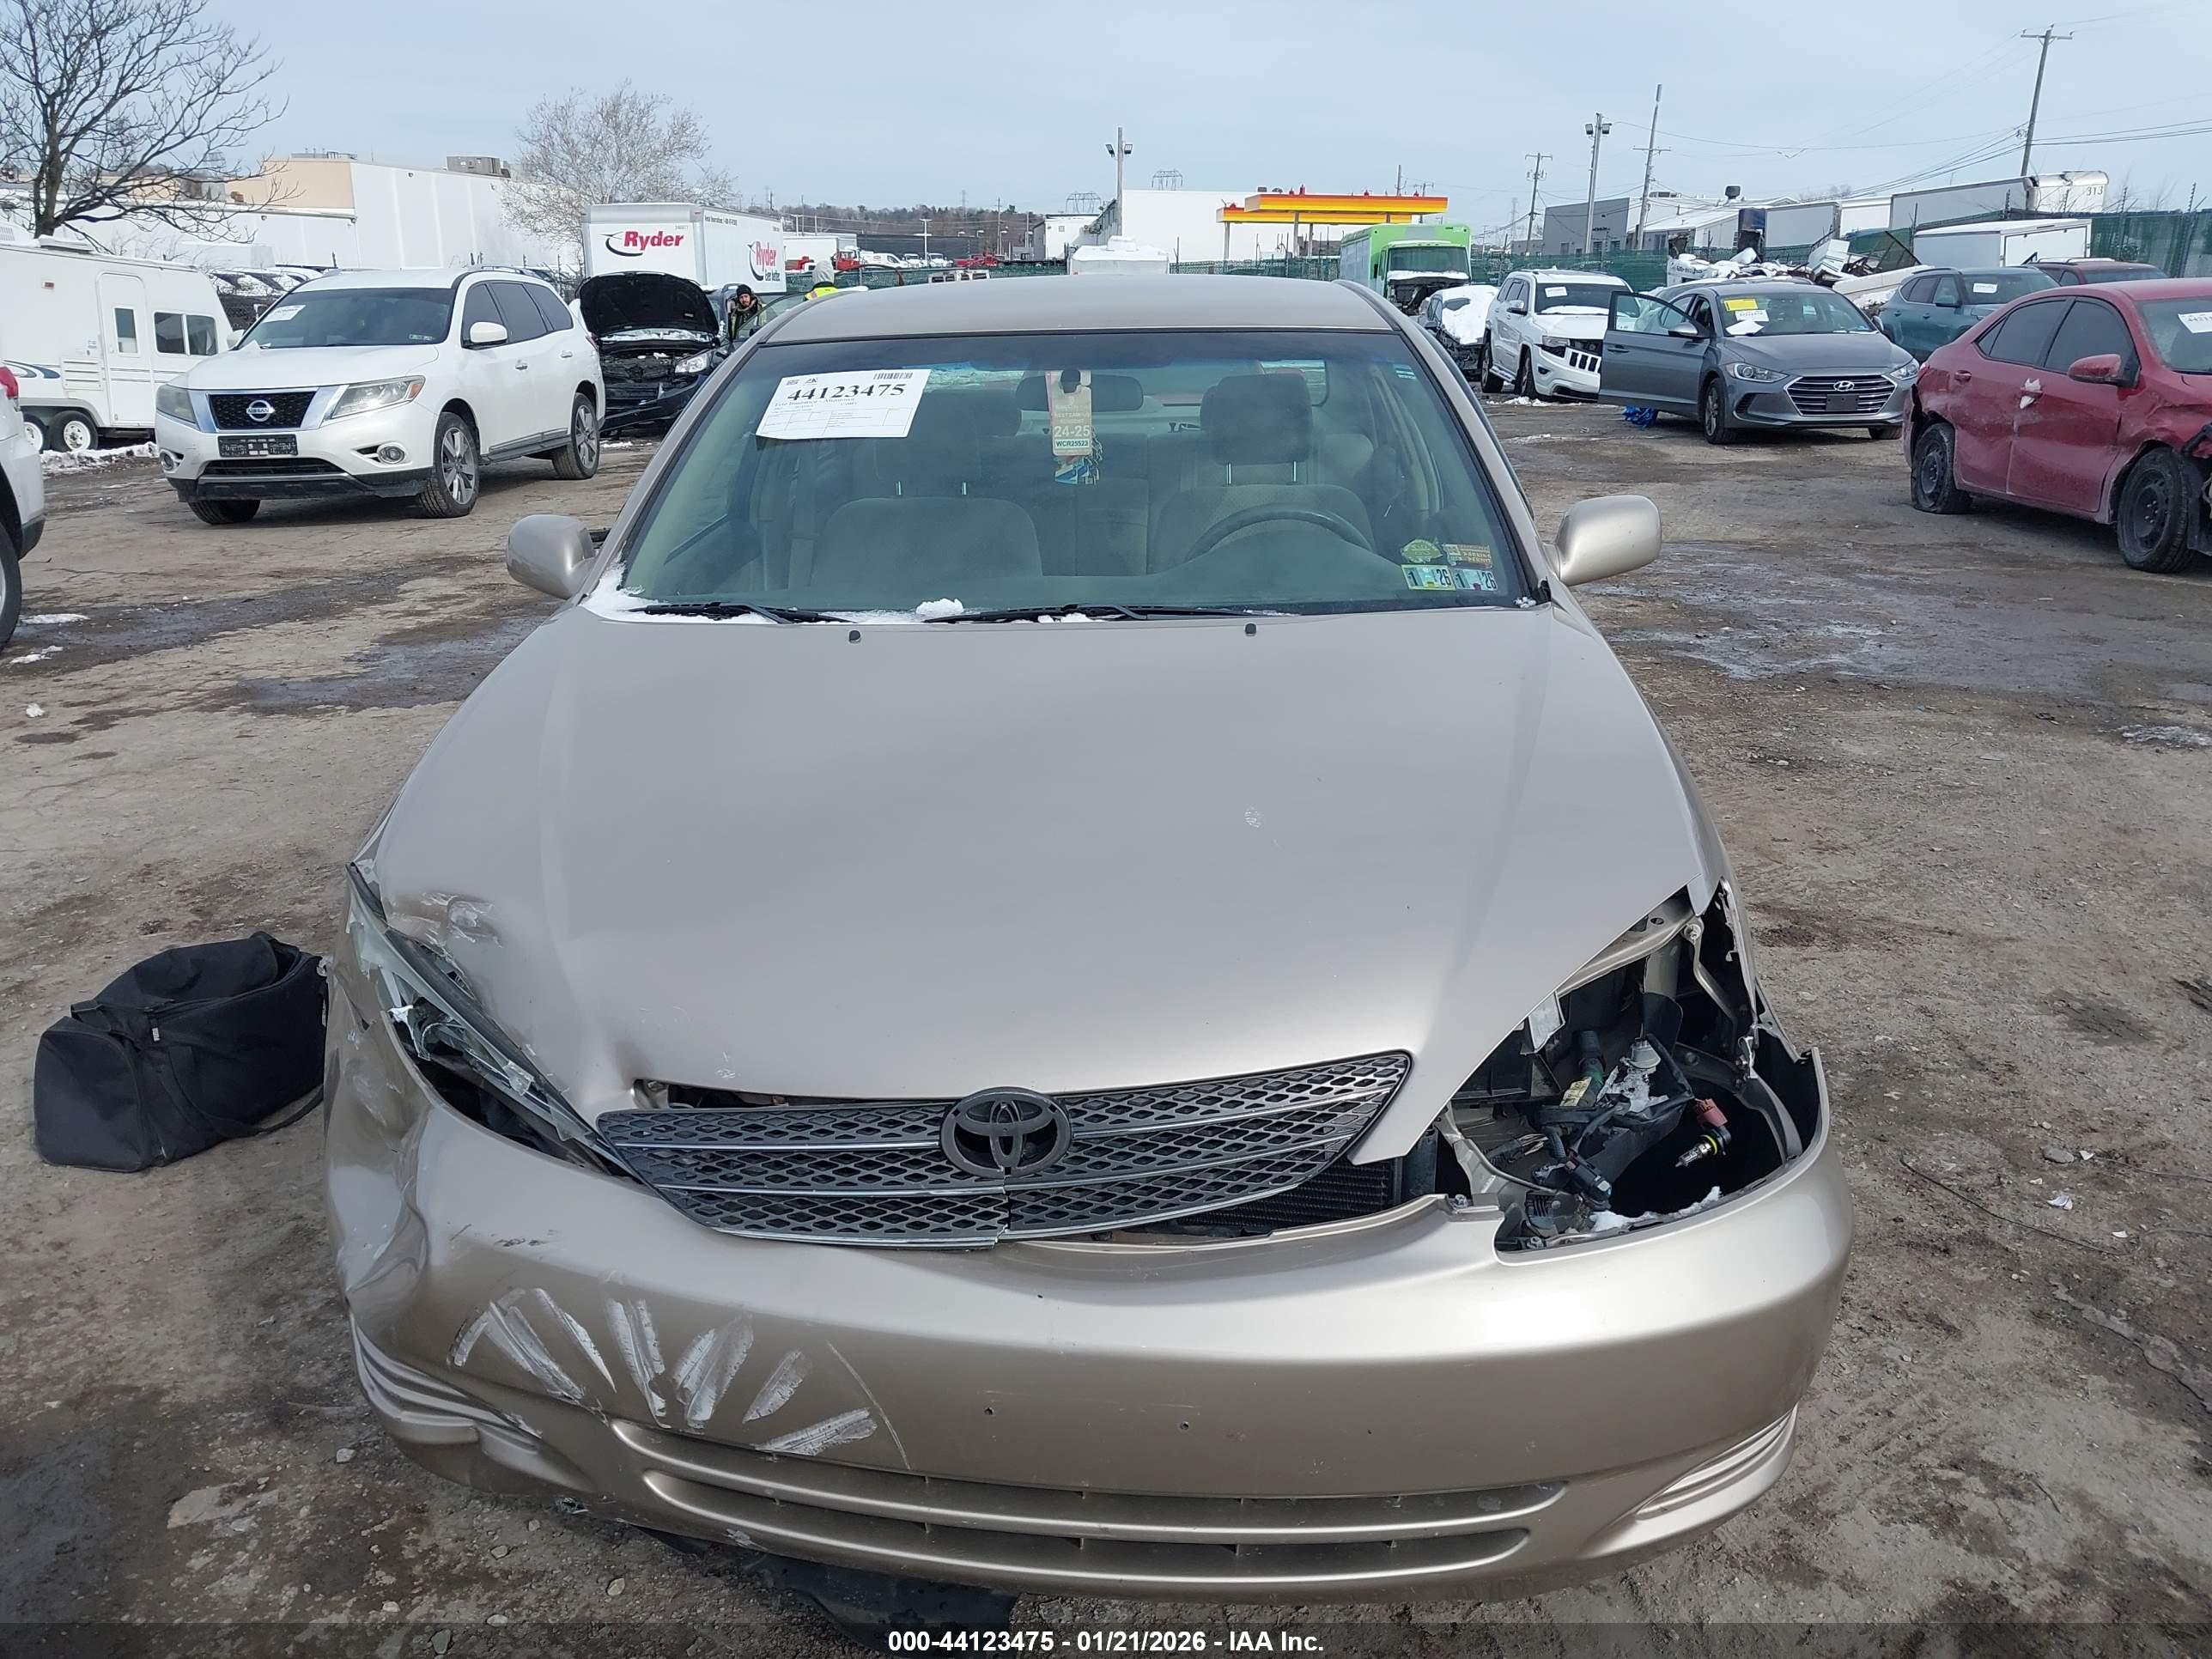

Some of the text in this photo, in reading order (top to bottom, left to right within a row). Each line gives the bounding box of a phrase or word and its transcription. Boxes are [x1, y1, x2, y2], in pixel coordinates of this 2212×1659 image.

[624, 230, 684, 251] Ryder
[756, 240, 777, 271] Ryder
[787, 383, 907, 401] 44123475
[1054, 425, 1091, 437] 24-25
[1408, 568, 1452, 586] 1 26
[1455, 572, 1497, 589] 1 26
